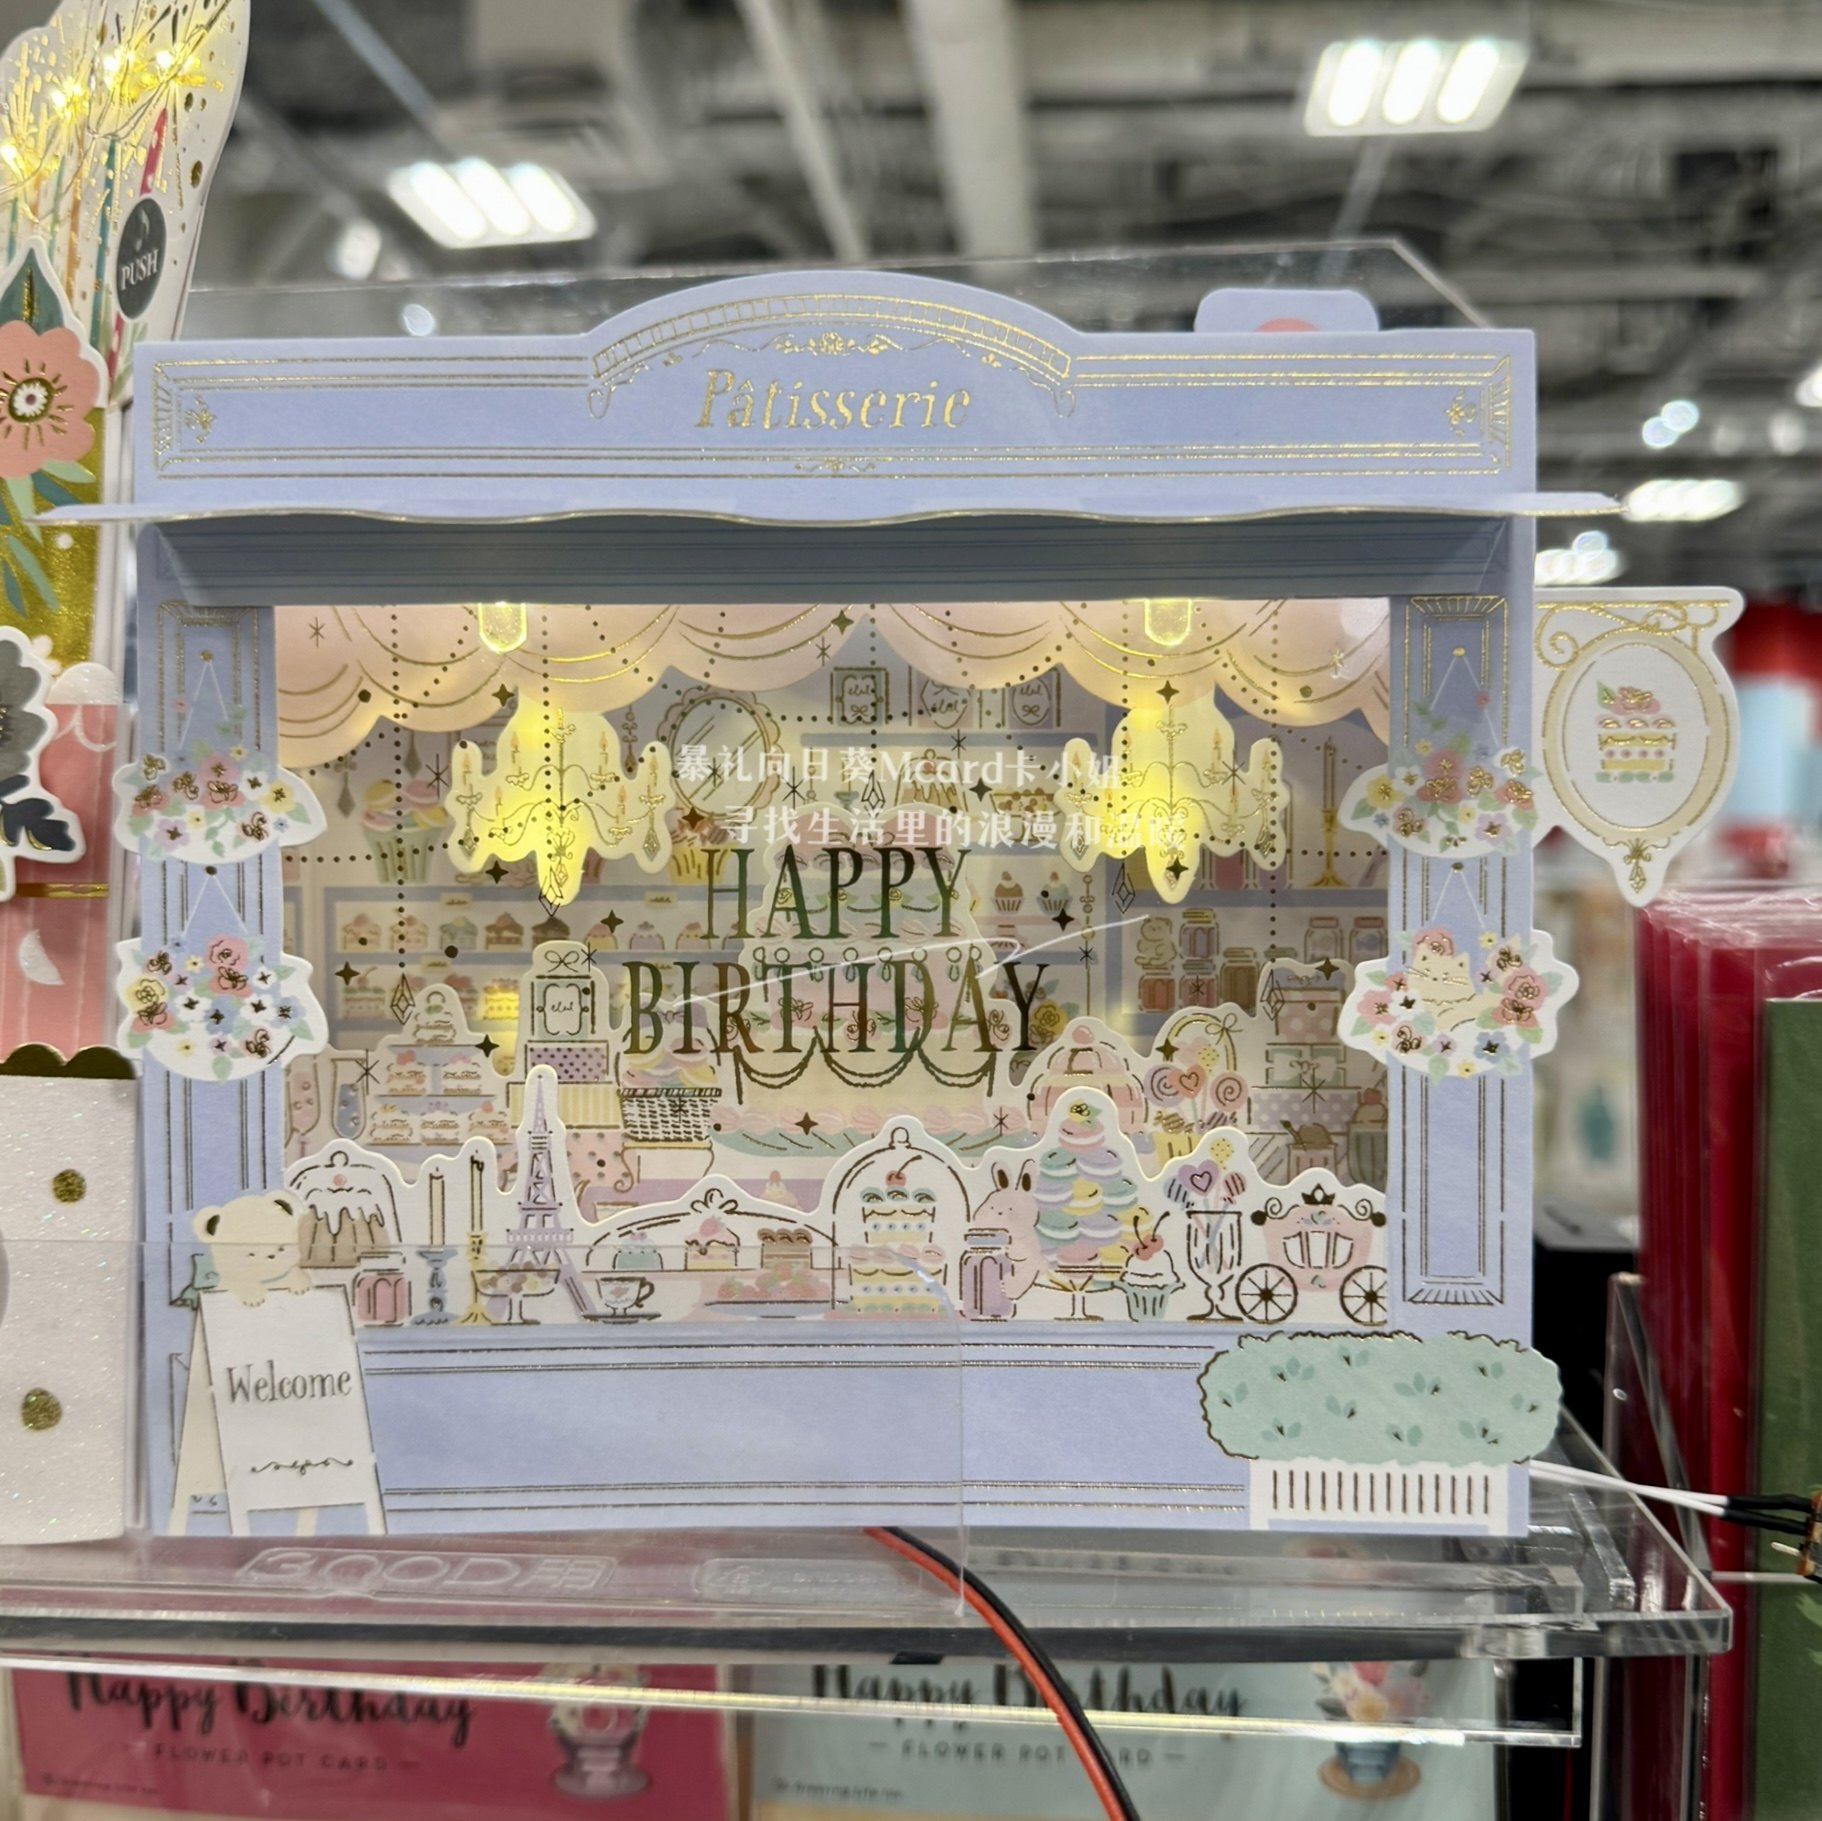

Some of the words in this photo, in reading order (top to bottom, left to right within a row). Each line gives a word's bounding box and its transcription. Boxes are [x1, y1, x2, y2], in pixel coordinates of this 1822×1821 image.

[121, 249, 160, 290] PUSH
[694, 368, 971, 430] Pâtisserie
[700, 845, 972, 940] HAPPY
[622, 955, 1051, 1055] BIRTHDAY
[226, 1360, 353, 1403] Welcome
[262, 1751, 304, 1768] POT
[321, 1754, 388, 1772] CARD
[902, 1738, 1005, 1762] FLOWER
[1019, 1744, 1066, 1765] POT
